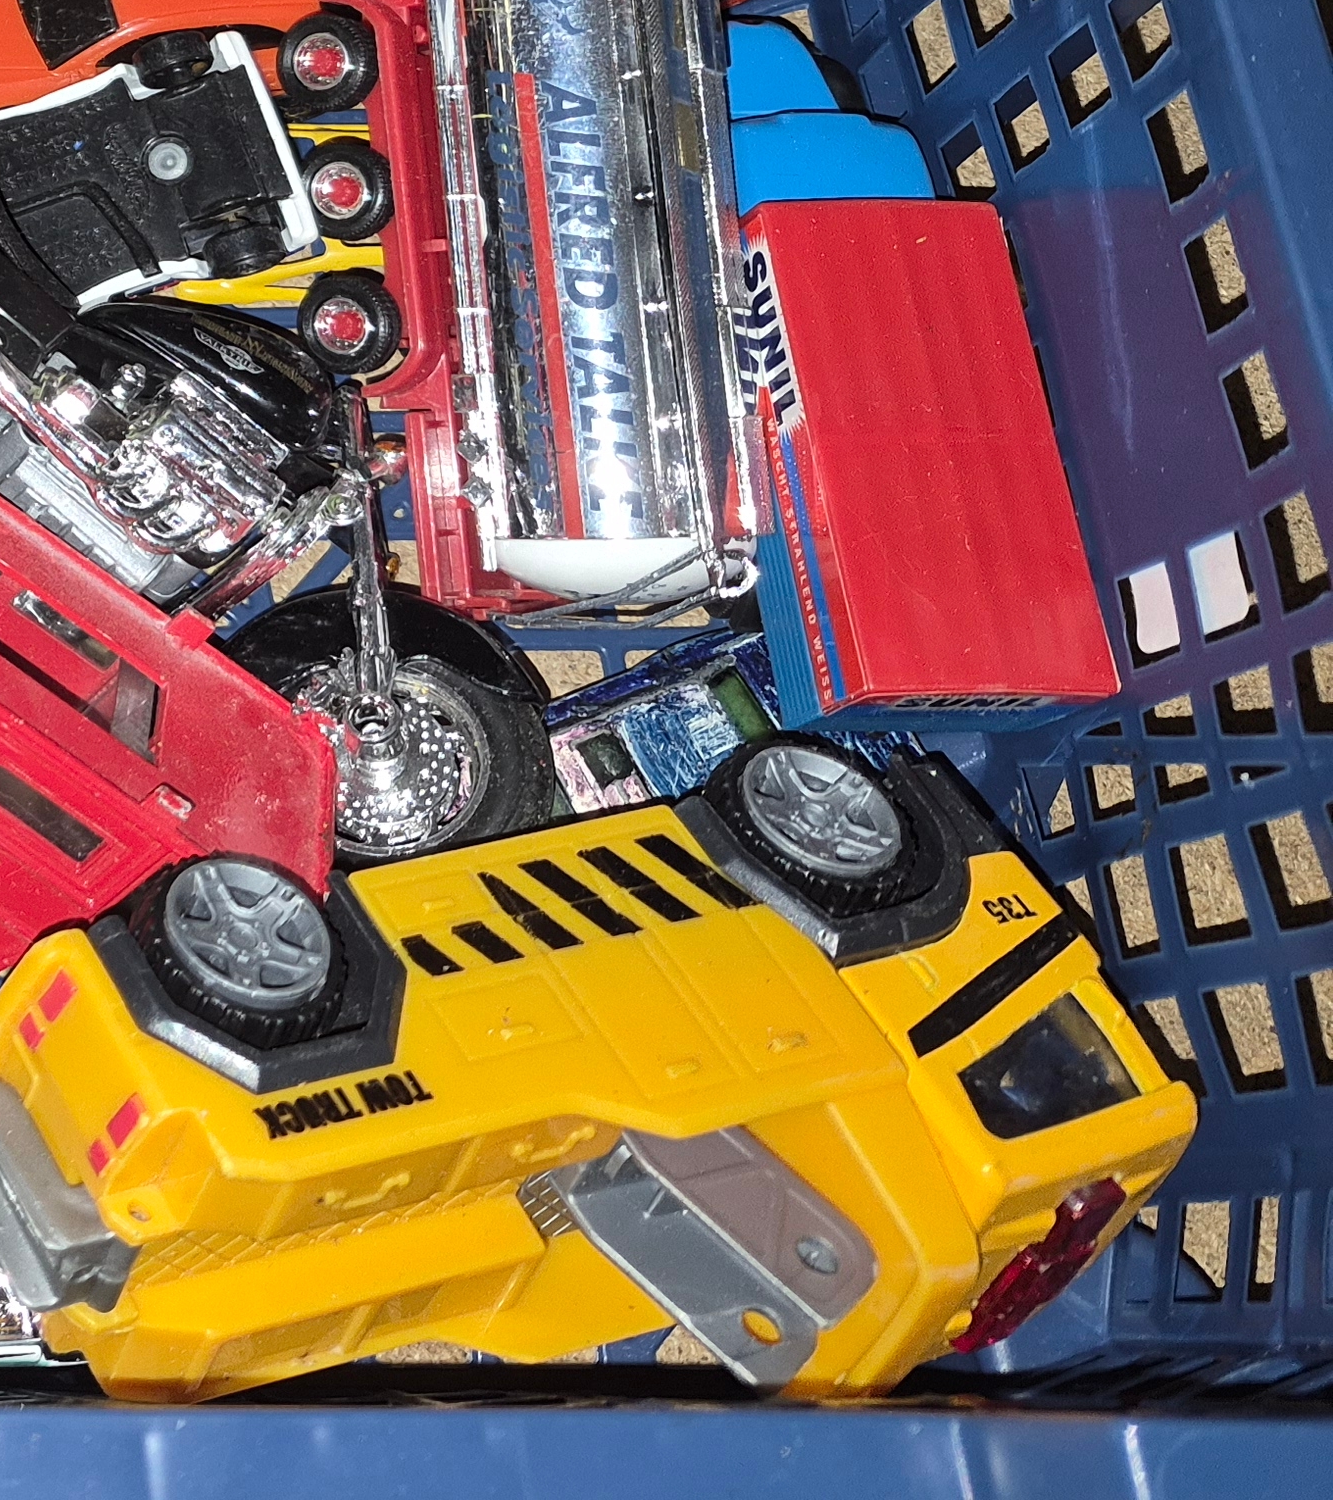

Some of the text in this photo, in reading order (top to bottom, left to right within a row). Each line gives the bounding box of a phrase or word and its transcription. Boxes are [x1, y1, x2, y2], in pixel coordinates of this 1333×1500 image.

[538, 75, 621, 315] ALFRED
[193, 332, 263, 371] VALKYRIE
[479, 68, 560, 514] Logistic Services
[738, 249, 801, 427] SUNIL
[783, 507, 817, 625] STRAHLEND
[810, 634, 833, 700] WEISS
[252, 1069, 435, 1140] TOW TRUCK
